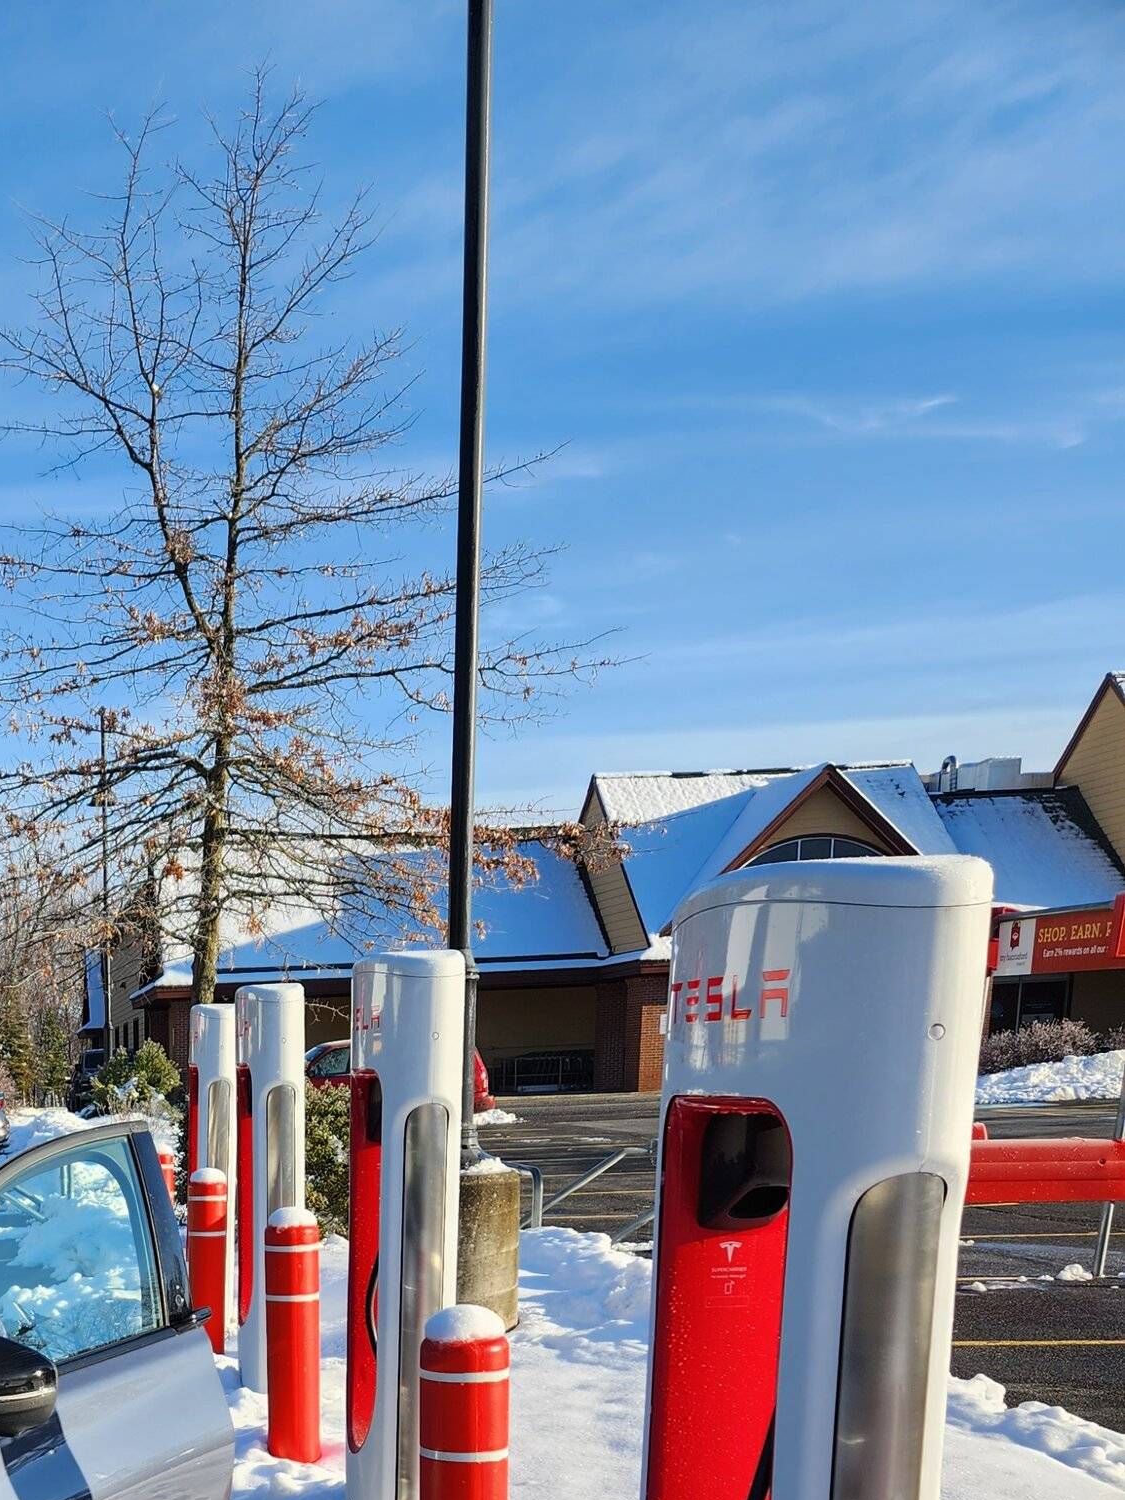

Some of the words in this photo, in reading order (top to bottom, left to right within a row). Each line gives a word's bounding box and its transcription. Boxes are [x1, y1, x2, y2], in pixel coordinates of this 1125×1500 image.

[1038, 926, 1067, 943] SHOP.
[1070, 922, 1103, 940] EARN.
[671, 969, 790, 1024] TESLA
